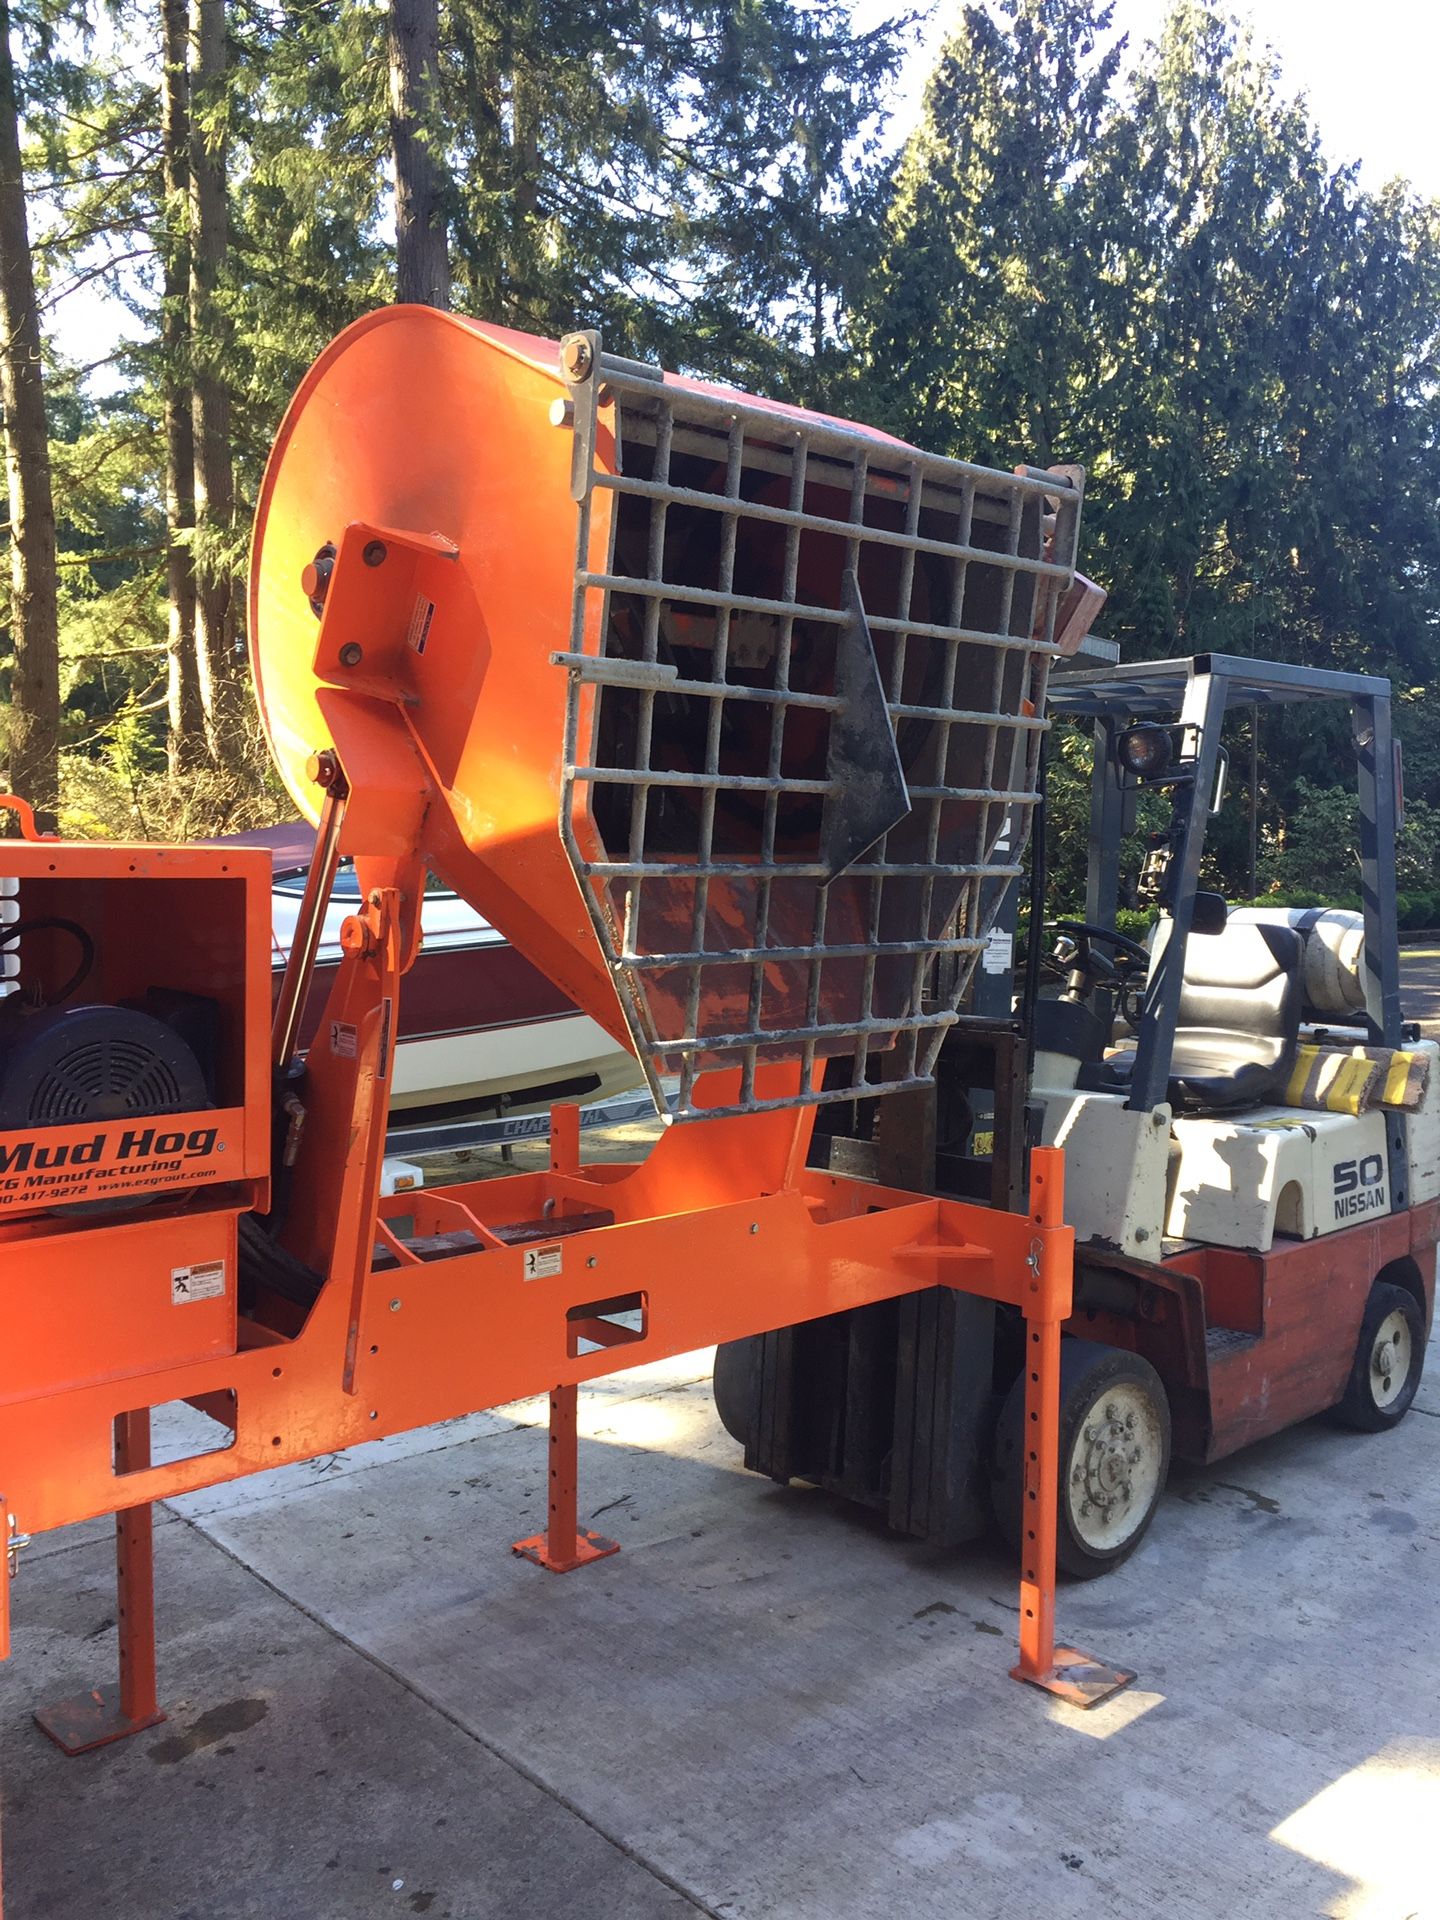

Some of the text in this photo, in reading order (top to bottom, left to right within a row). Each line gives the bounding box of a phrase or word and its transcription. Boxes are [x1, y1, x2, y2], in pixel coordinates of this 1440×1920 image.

[504, 1109, 604, 1136] CHAPAL
[0, 1128, 219, 1173] Mud Hog
[0, 1170, 217, 1204] 0-417-9272 www.ezgrout.com
[24, 1160, 182, 1188] Manufacturing
[1333, 1154, 1383, 1195] 50
[1334, 1187, 1385, 1220] NISSAN
